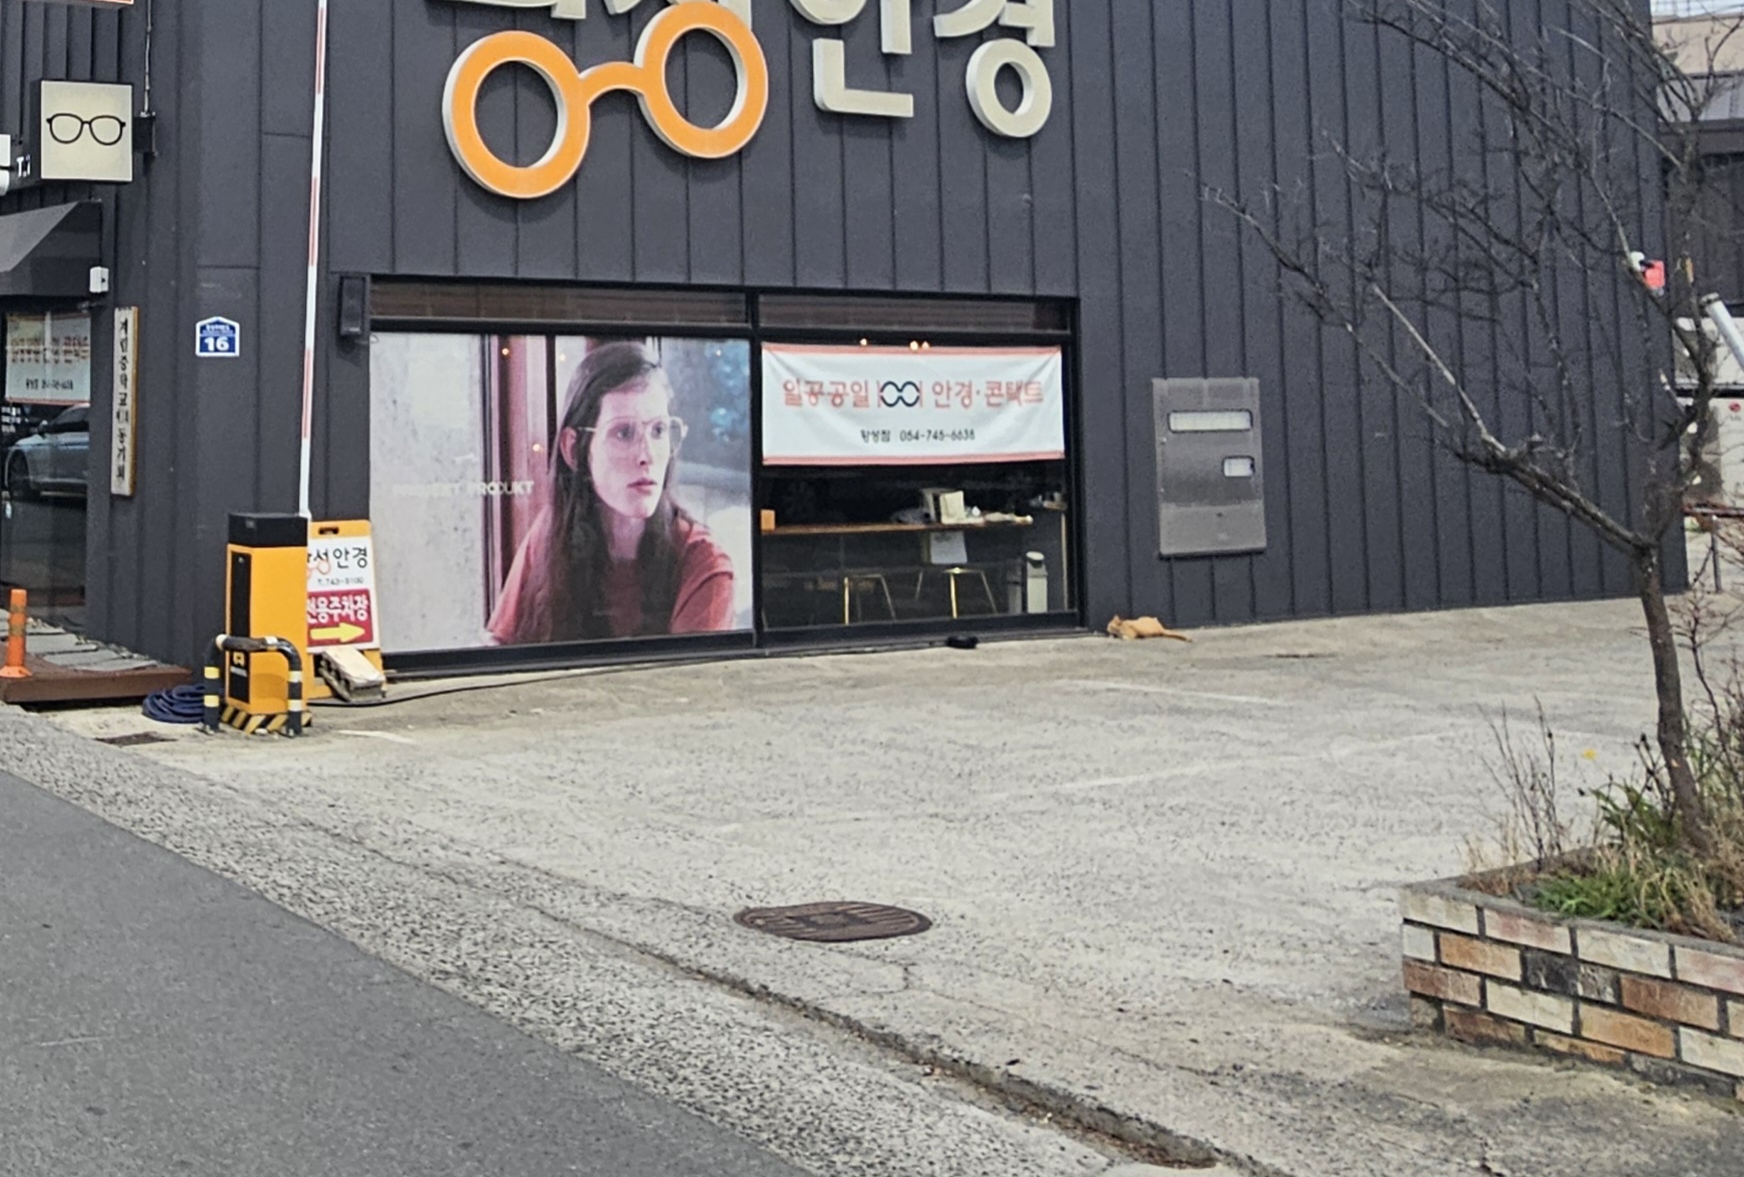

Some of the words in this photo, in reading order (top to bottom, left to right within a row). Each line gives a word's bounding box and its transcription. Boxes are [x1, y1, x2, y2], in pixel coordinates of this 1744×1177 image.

[204, 336, 230, 352] 16
[782, 379, 870, 408] 일공공일
[307, 546, 368, 575] 성안경
